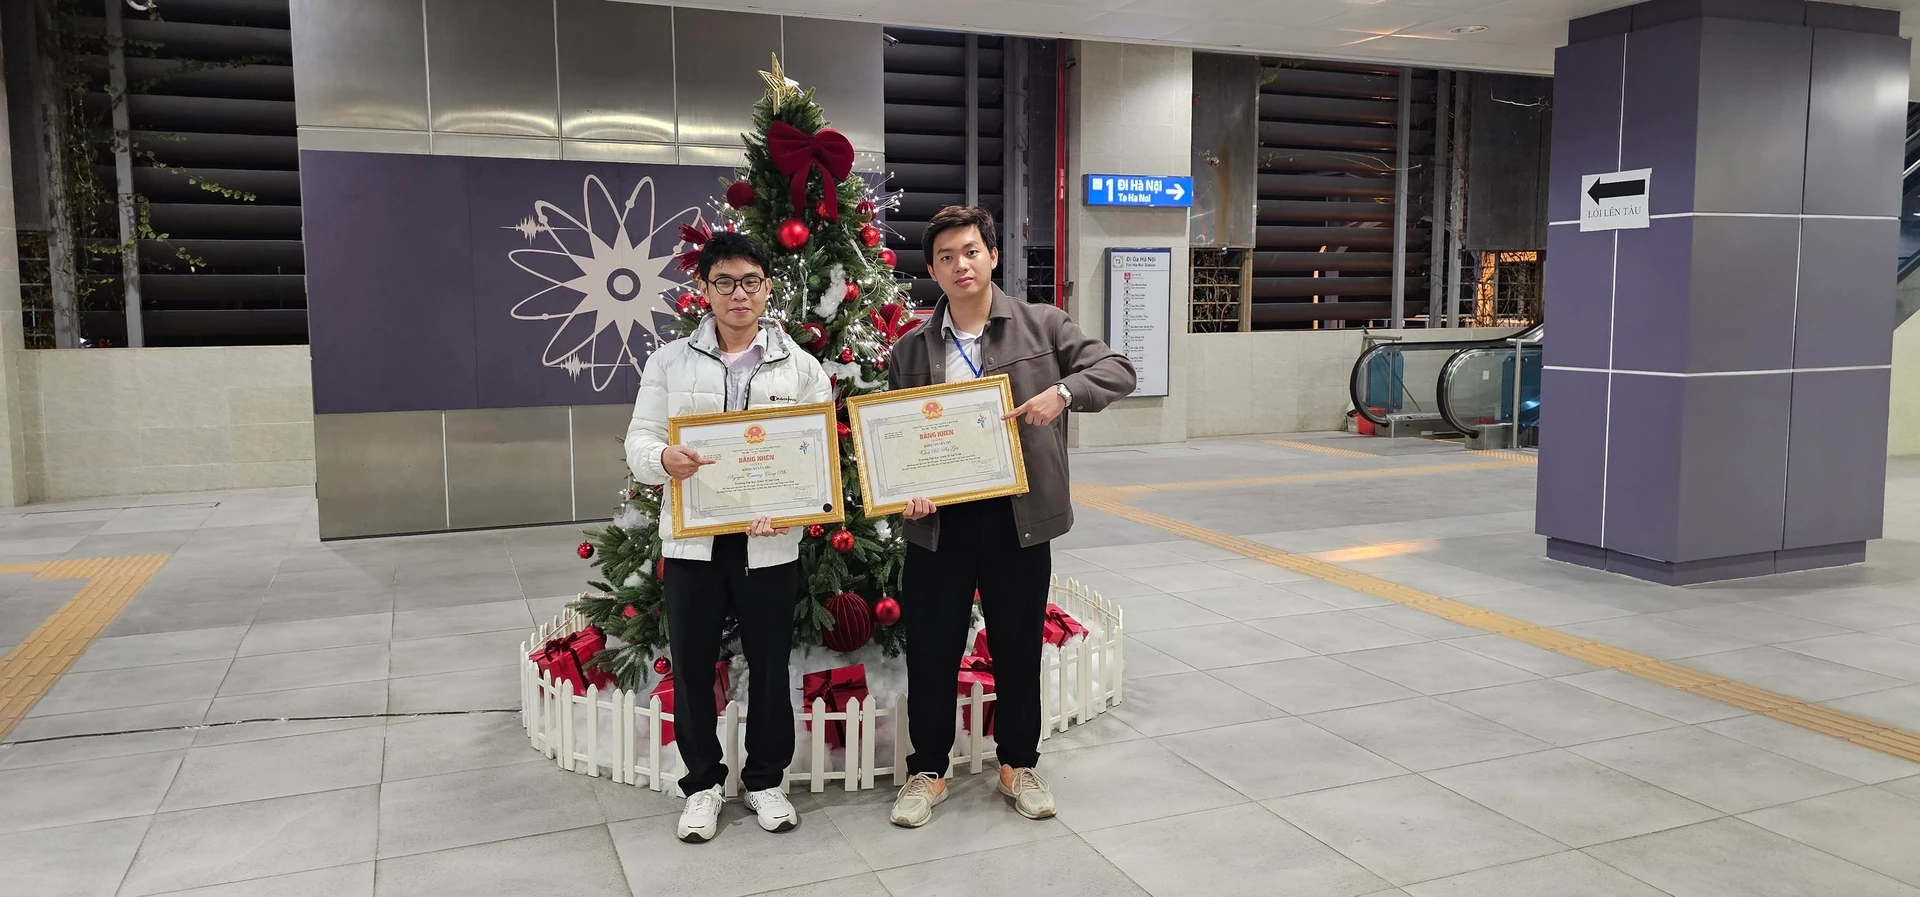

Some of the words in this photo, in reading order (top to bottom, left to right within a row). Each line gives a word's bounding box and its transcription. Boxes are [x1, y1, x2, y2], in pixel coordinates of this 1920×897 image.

[1106, 178, 1114, 202] 1
[1117, 179, 1129, 191] Đi
[1130, 179, 1144, 192] Hà
[1145, 180, 1163, 195] Nội
[1117, 193, 1127, 202] To
[1128, 193, 1139, 202] Ha
[1604, 206, 1621, 217] LÊN
[1623, 204, 1642, 216] TÀU
[937, 429, 954, 438] KHEN
[756, 454, 775, 462] KHEN
